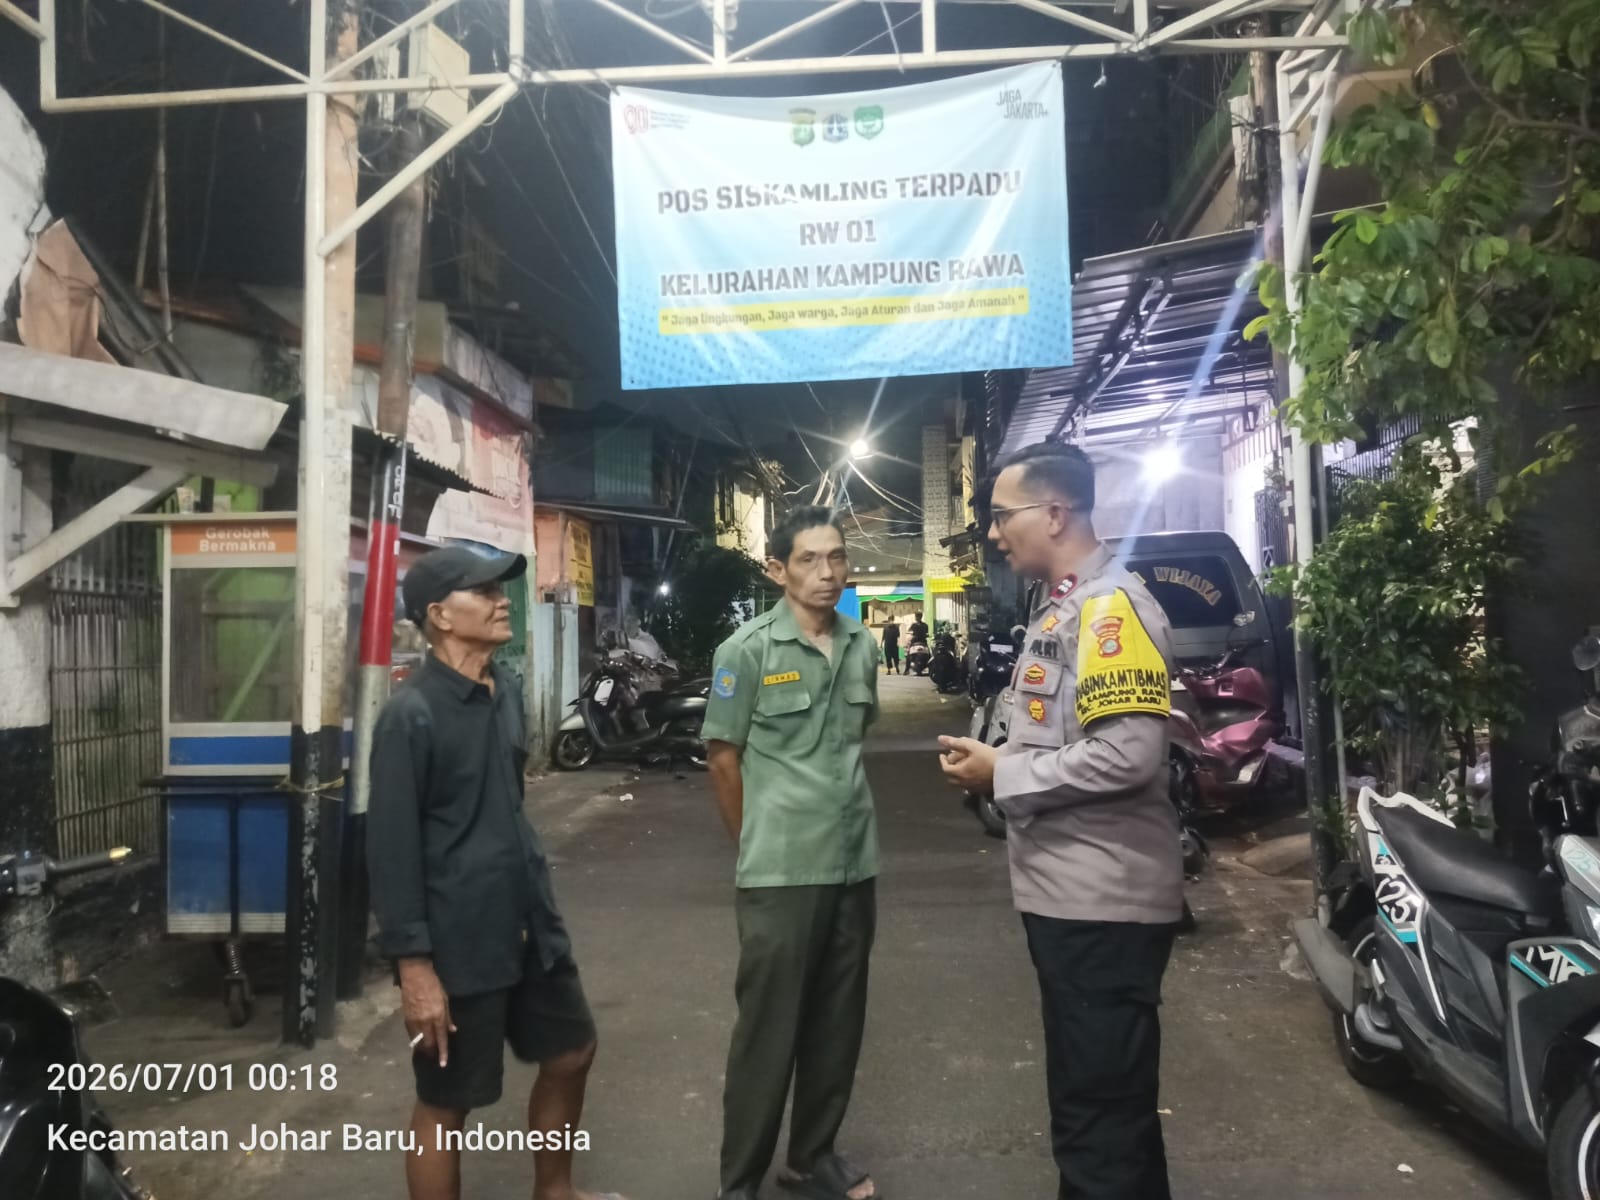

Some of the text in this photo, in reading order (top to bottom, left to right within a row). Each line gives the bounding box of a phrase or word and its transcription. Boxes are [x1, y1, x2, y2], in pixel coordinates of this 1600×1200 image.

[657, 170, 1021, 215] POS SISKAMLING TERPADU
[799, 219, 877, 246] RW 01
[660, 253, 1025, 297] KELURAHAN KAMPUNG RAWA
[671, 315, 699, 326] Jaga
[768, 309, 796, 321] Jaga
[797, 306, 839, 320] warga,
[841, 305, 869, 318] Jaga
[871, 303, 911, 316] Aturan
[913, 301, 935, 313] dan
[937, 299, 966, 312] Jaga
[968, 294, 1016, 308] Amanah
[199, 539, 276, 552] Bermakna
[206, 527, 270, 539] Gerobak
[1098, 695, 1131, 708] JOHAR
[1136, 695, 1161, 706] BARU
